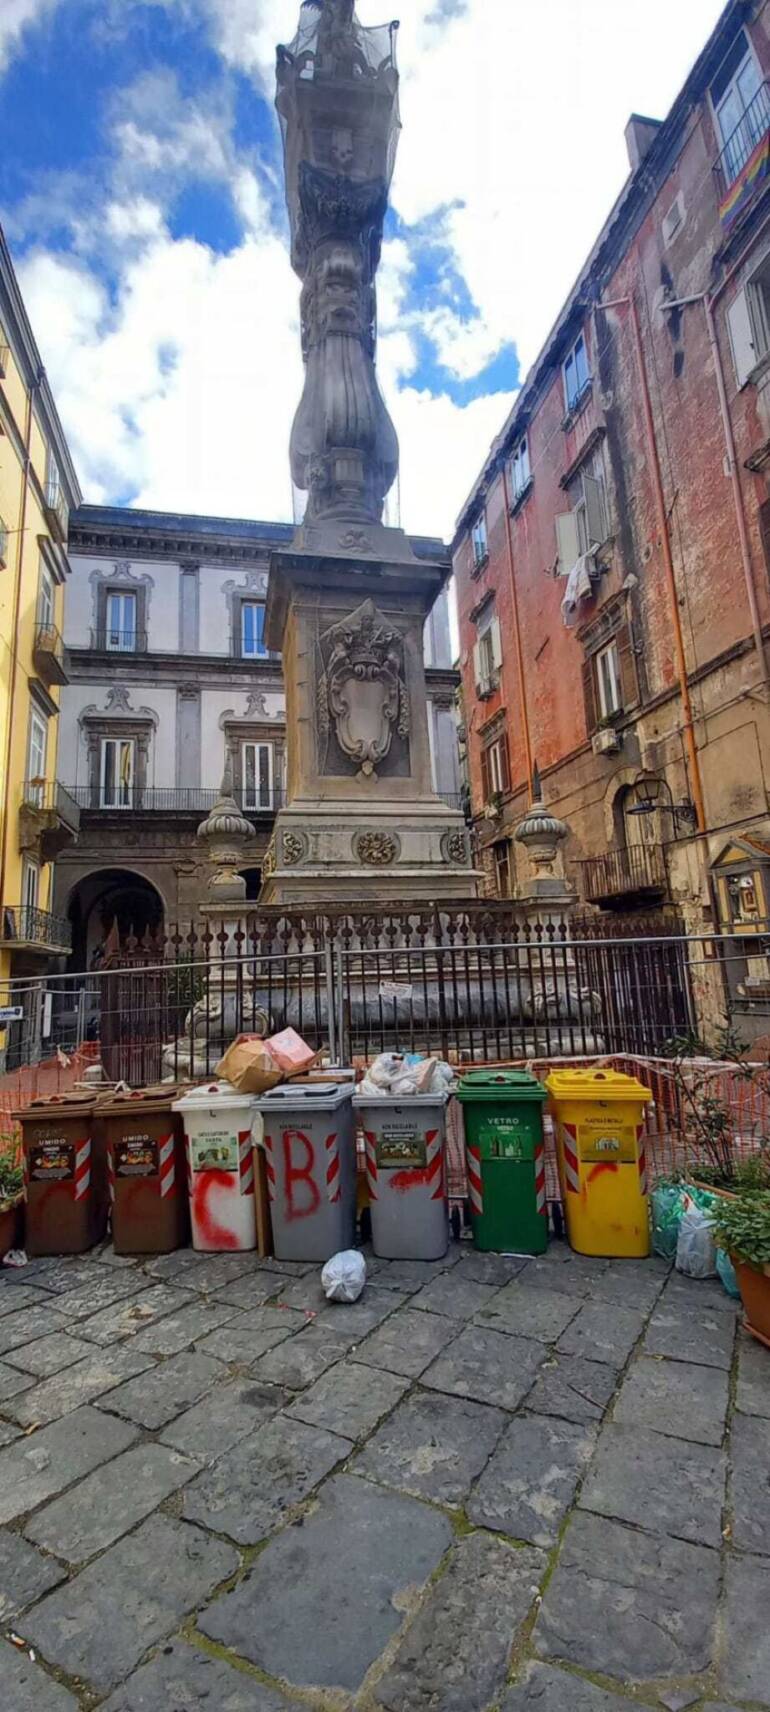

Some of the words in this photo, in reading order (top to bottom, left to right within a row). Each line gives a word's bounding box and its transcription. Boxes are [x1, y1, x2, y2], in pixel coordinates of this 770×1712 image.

[487, 1117, 520, 1125] VETRO
[38, 1138, 66, 1146] UMIDO
[122, 1134, 149, 1142] UMIDO
[283, 1130, 320, 1222] B
[194, 1167, 240, 1249] C
